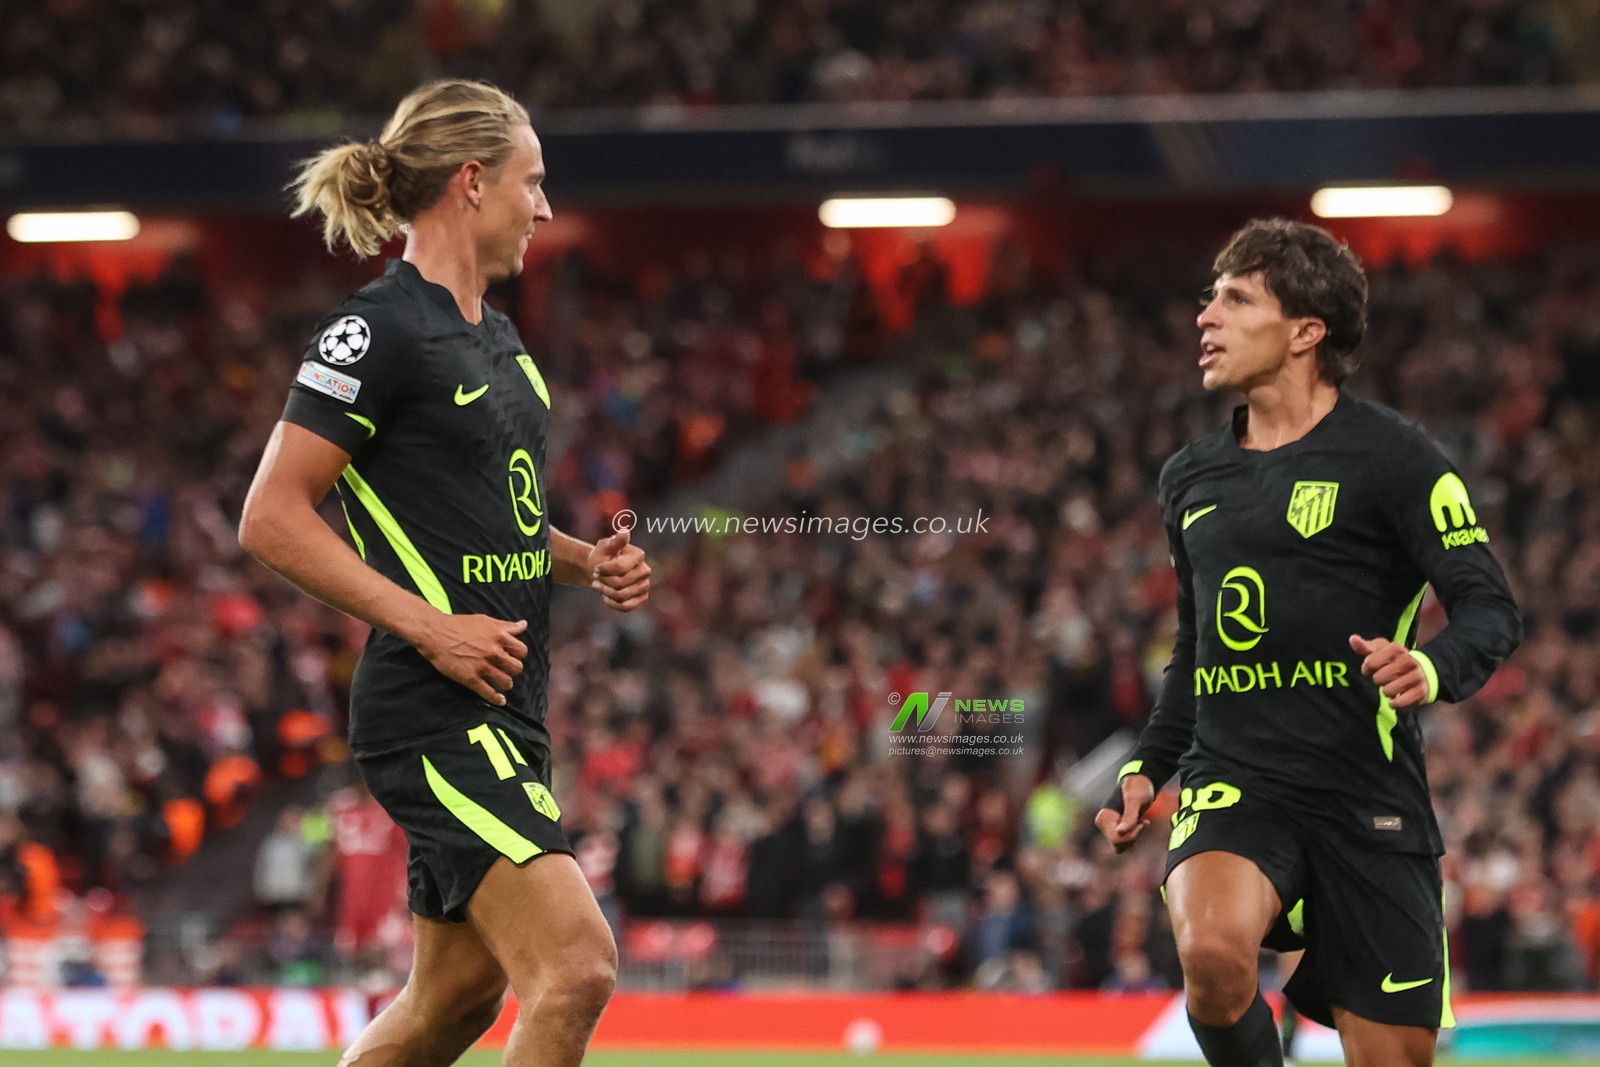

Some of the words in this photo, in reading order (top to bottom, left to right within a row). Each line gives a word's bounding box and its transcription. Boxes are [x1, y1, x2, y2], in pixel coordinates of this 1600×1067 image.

[462, 549, 545, 584] RIYADH
[1194, 661, 1283, 696] IYADH
[1290, 660, 1350, 689] AIR
